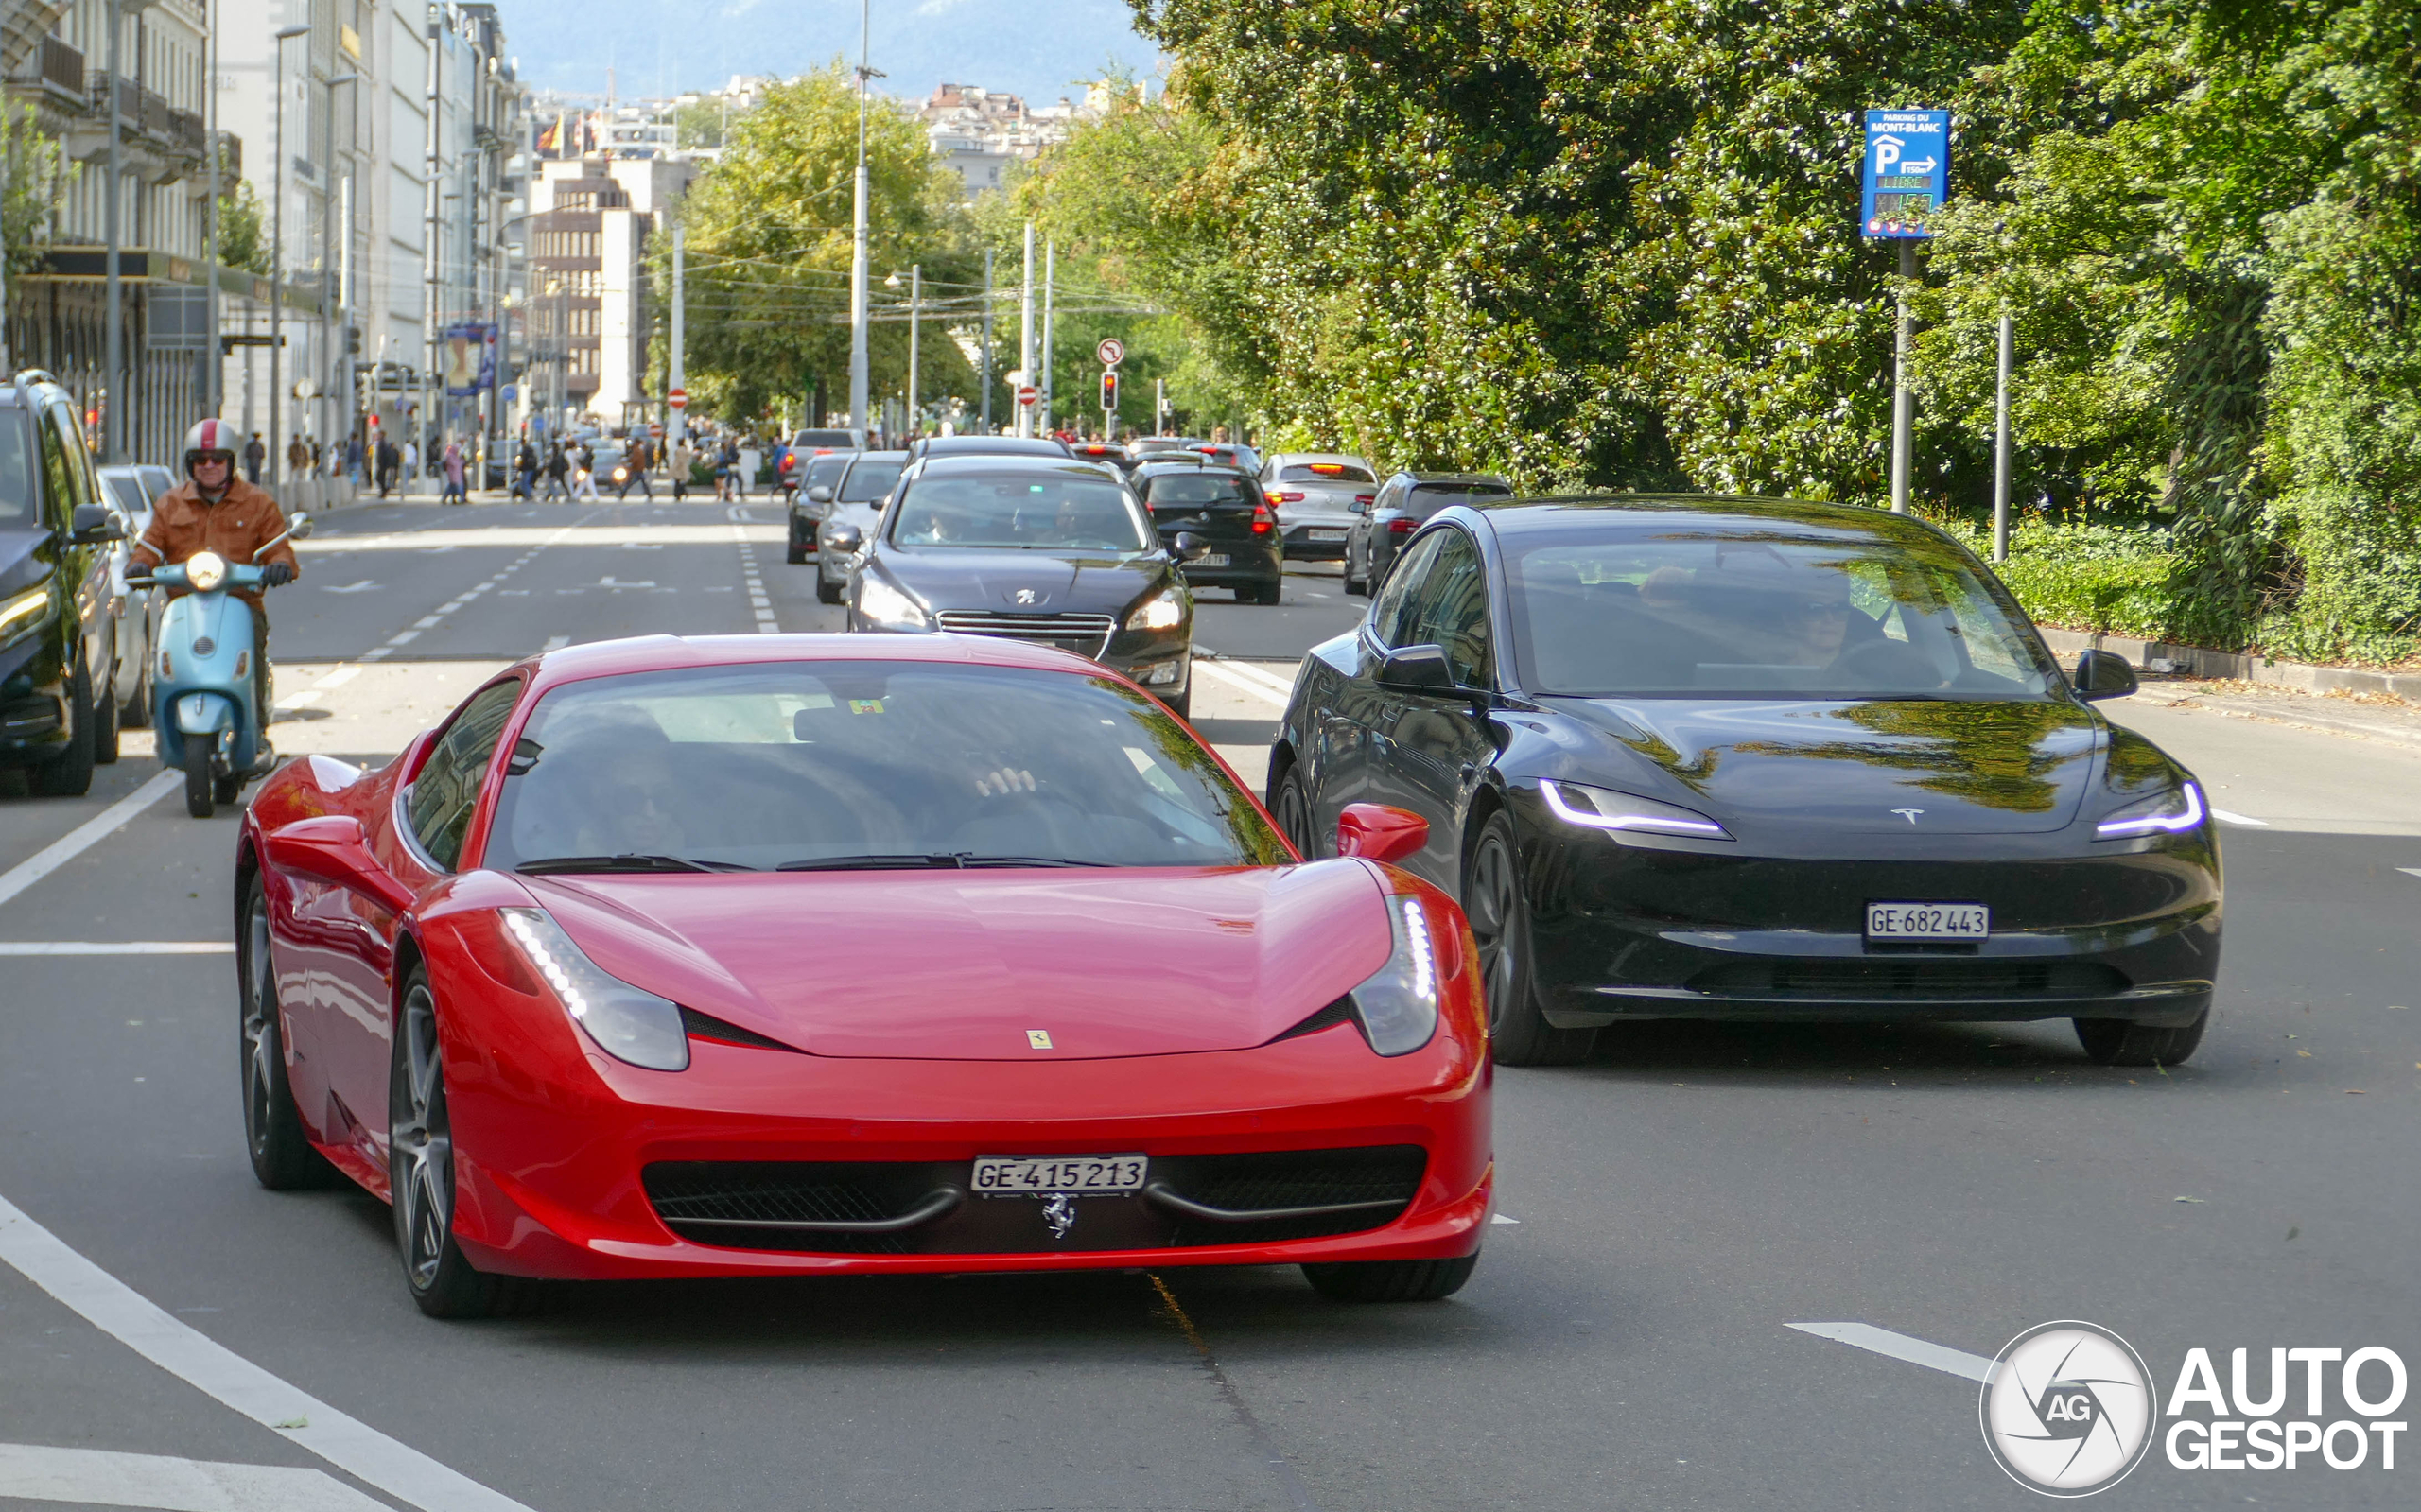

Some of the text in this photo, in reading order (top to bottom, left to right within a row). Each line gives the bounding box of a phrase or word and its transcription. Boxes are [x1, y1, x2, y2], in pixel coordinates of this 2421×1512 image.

[1872, 123, 1941, 132] MONT-BLANC
[1876, 144, 1900, 174] P
[1884, 176, 1923, 188] LIBRE
